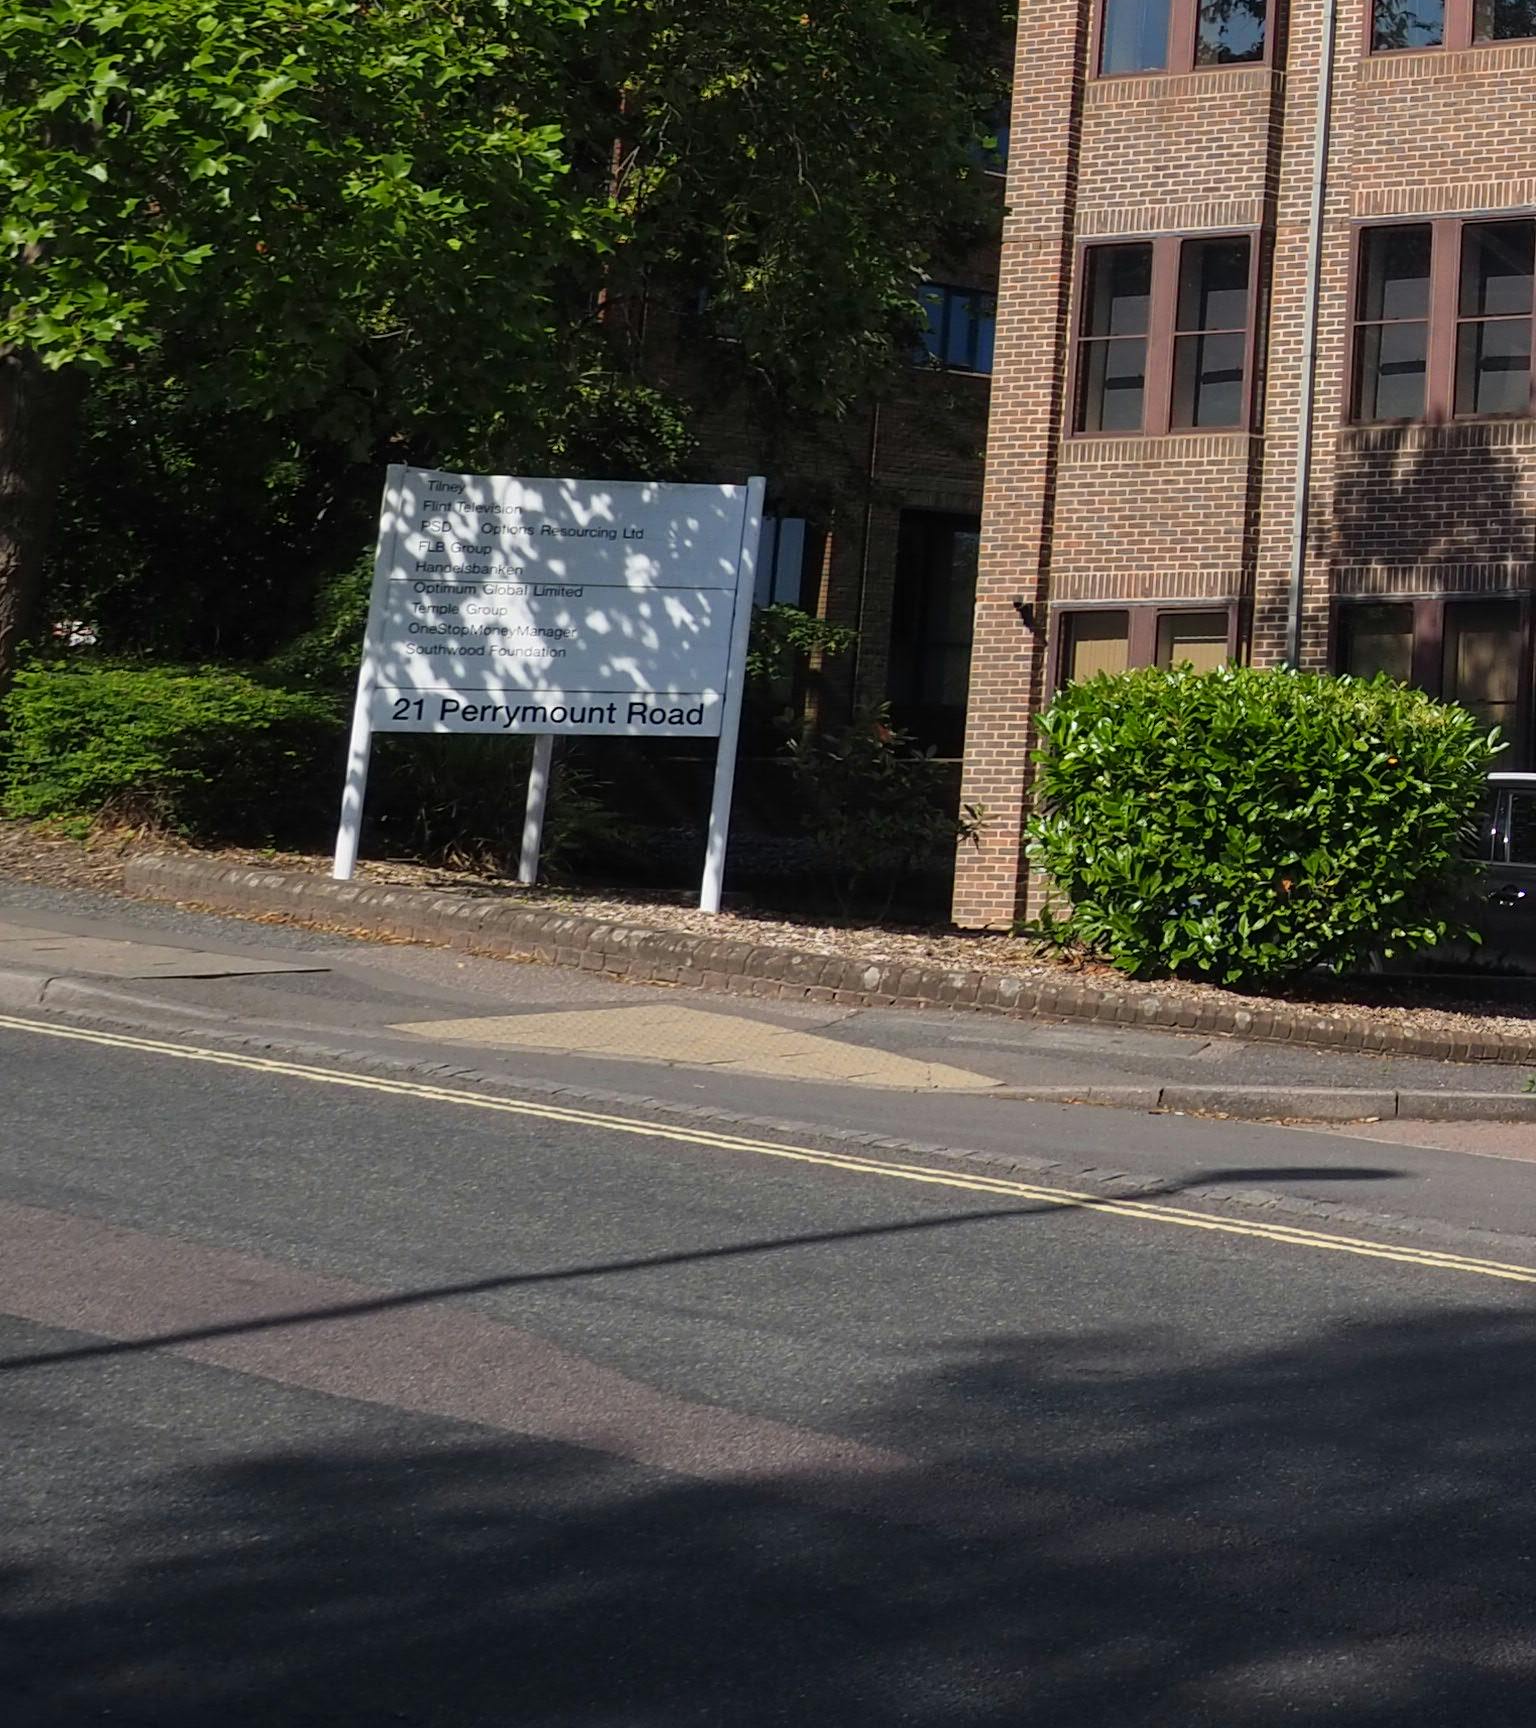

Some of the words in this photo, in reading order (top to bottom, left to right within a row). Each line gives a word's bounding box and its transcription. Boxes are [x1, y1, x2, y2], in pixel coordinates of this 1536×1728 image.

[427, 480, 466, 494] Tilney
[423, 501, 451, 513] Flint
[456, 501, 523, 515] Television
[421, 520, 452, 533] PSD
[481, 523, 535, 536] Options
[540, 524, 617, 541] Resourcing
[623, 528, 645, 540] Ltd
[418, 541, 445, 553] FLB
[450, 542, 493, 556] Group
[415, 561, 524, 576] Handelsbanken
[413, 581, 477, 596] Optimum
[482, 583, 529, 596] Global
[533, 585, 584, 598] Limited
[412, 602, 460, 618] Temple
[466, 603, 508, 617] Group
[408, 622, 577, 640] OneStopMoneyManager
[405, 642, 486, 656] Southwood
[489, 645, 566, 658] Foundation
[392, 698, 425, 721] 21
[439, 698, 617, 728] Perrymount
[627, 702, 705, 725] Road
